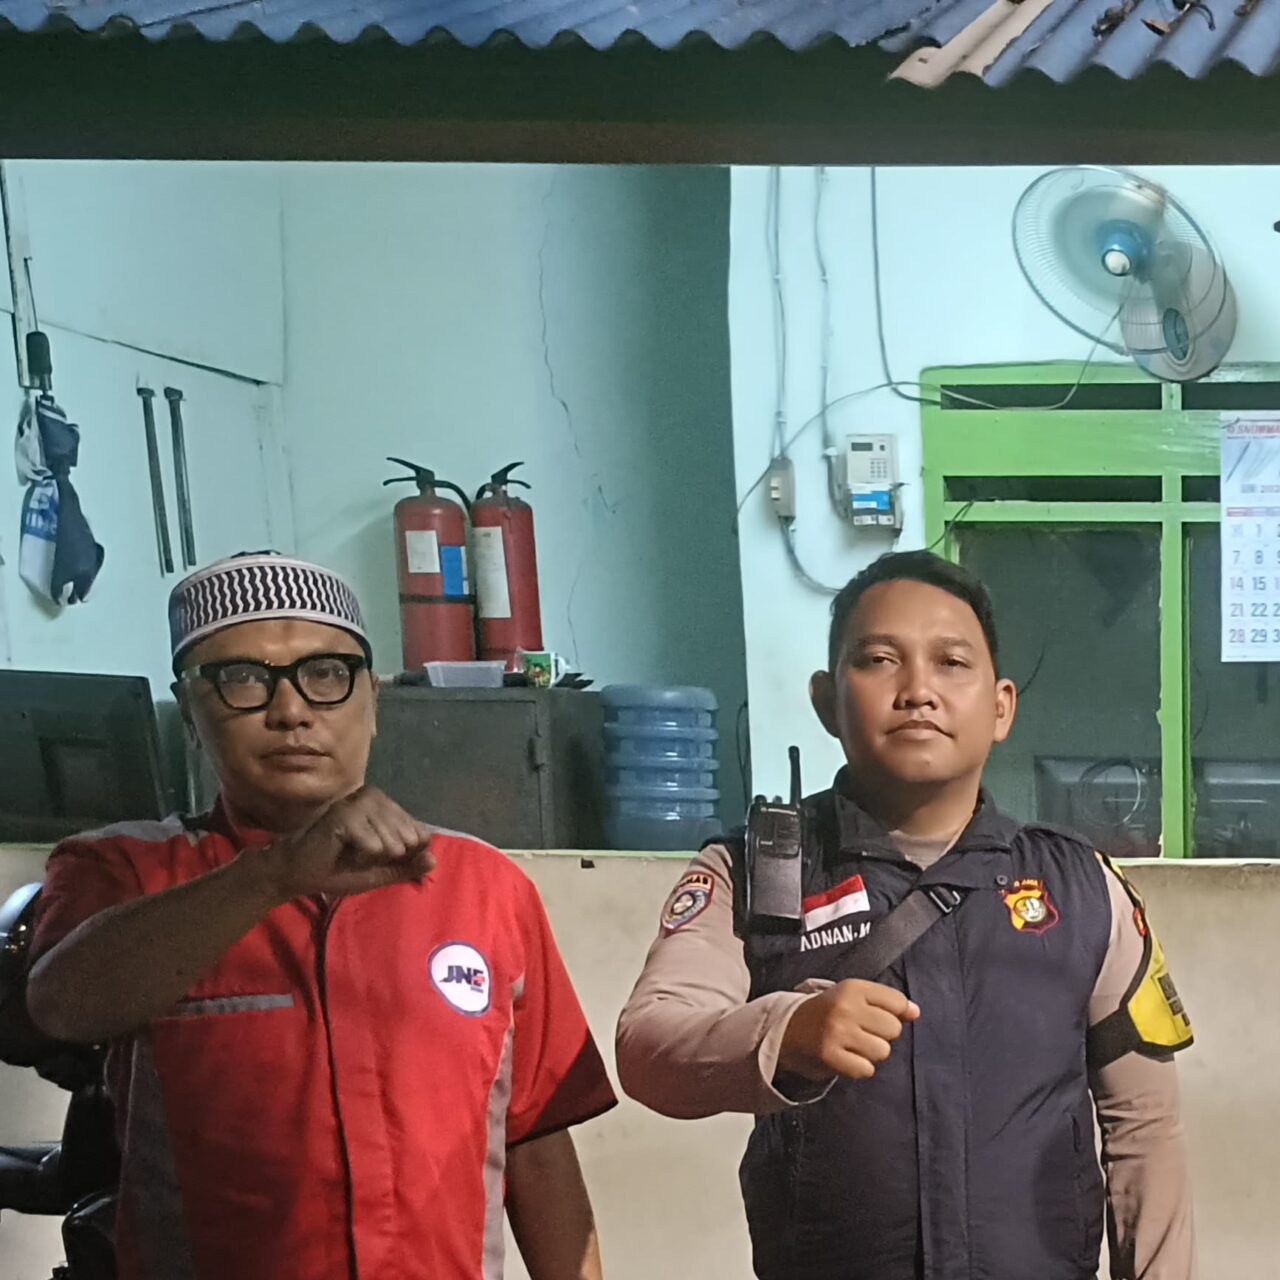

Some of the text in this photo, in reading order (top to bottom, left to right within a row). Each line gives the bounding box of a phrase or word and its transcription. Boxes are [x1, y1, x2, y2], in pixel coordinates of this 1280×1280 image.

[1232, 549, 1241, 564] 7
[1254, 549, 1264, 564] 8
[1230, 576, 1244, 591] 14
[1252, 576, 1266, 591] 15
[1230, 602, 1244, 617] 21
[1250, 602, 1267, 617] 22
[1229, 628, 1245, 643] 28
[1250, 628, 1268, 643] 29
[439, 965, 485, 987] JNE
